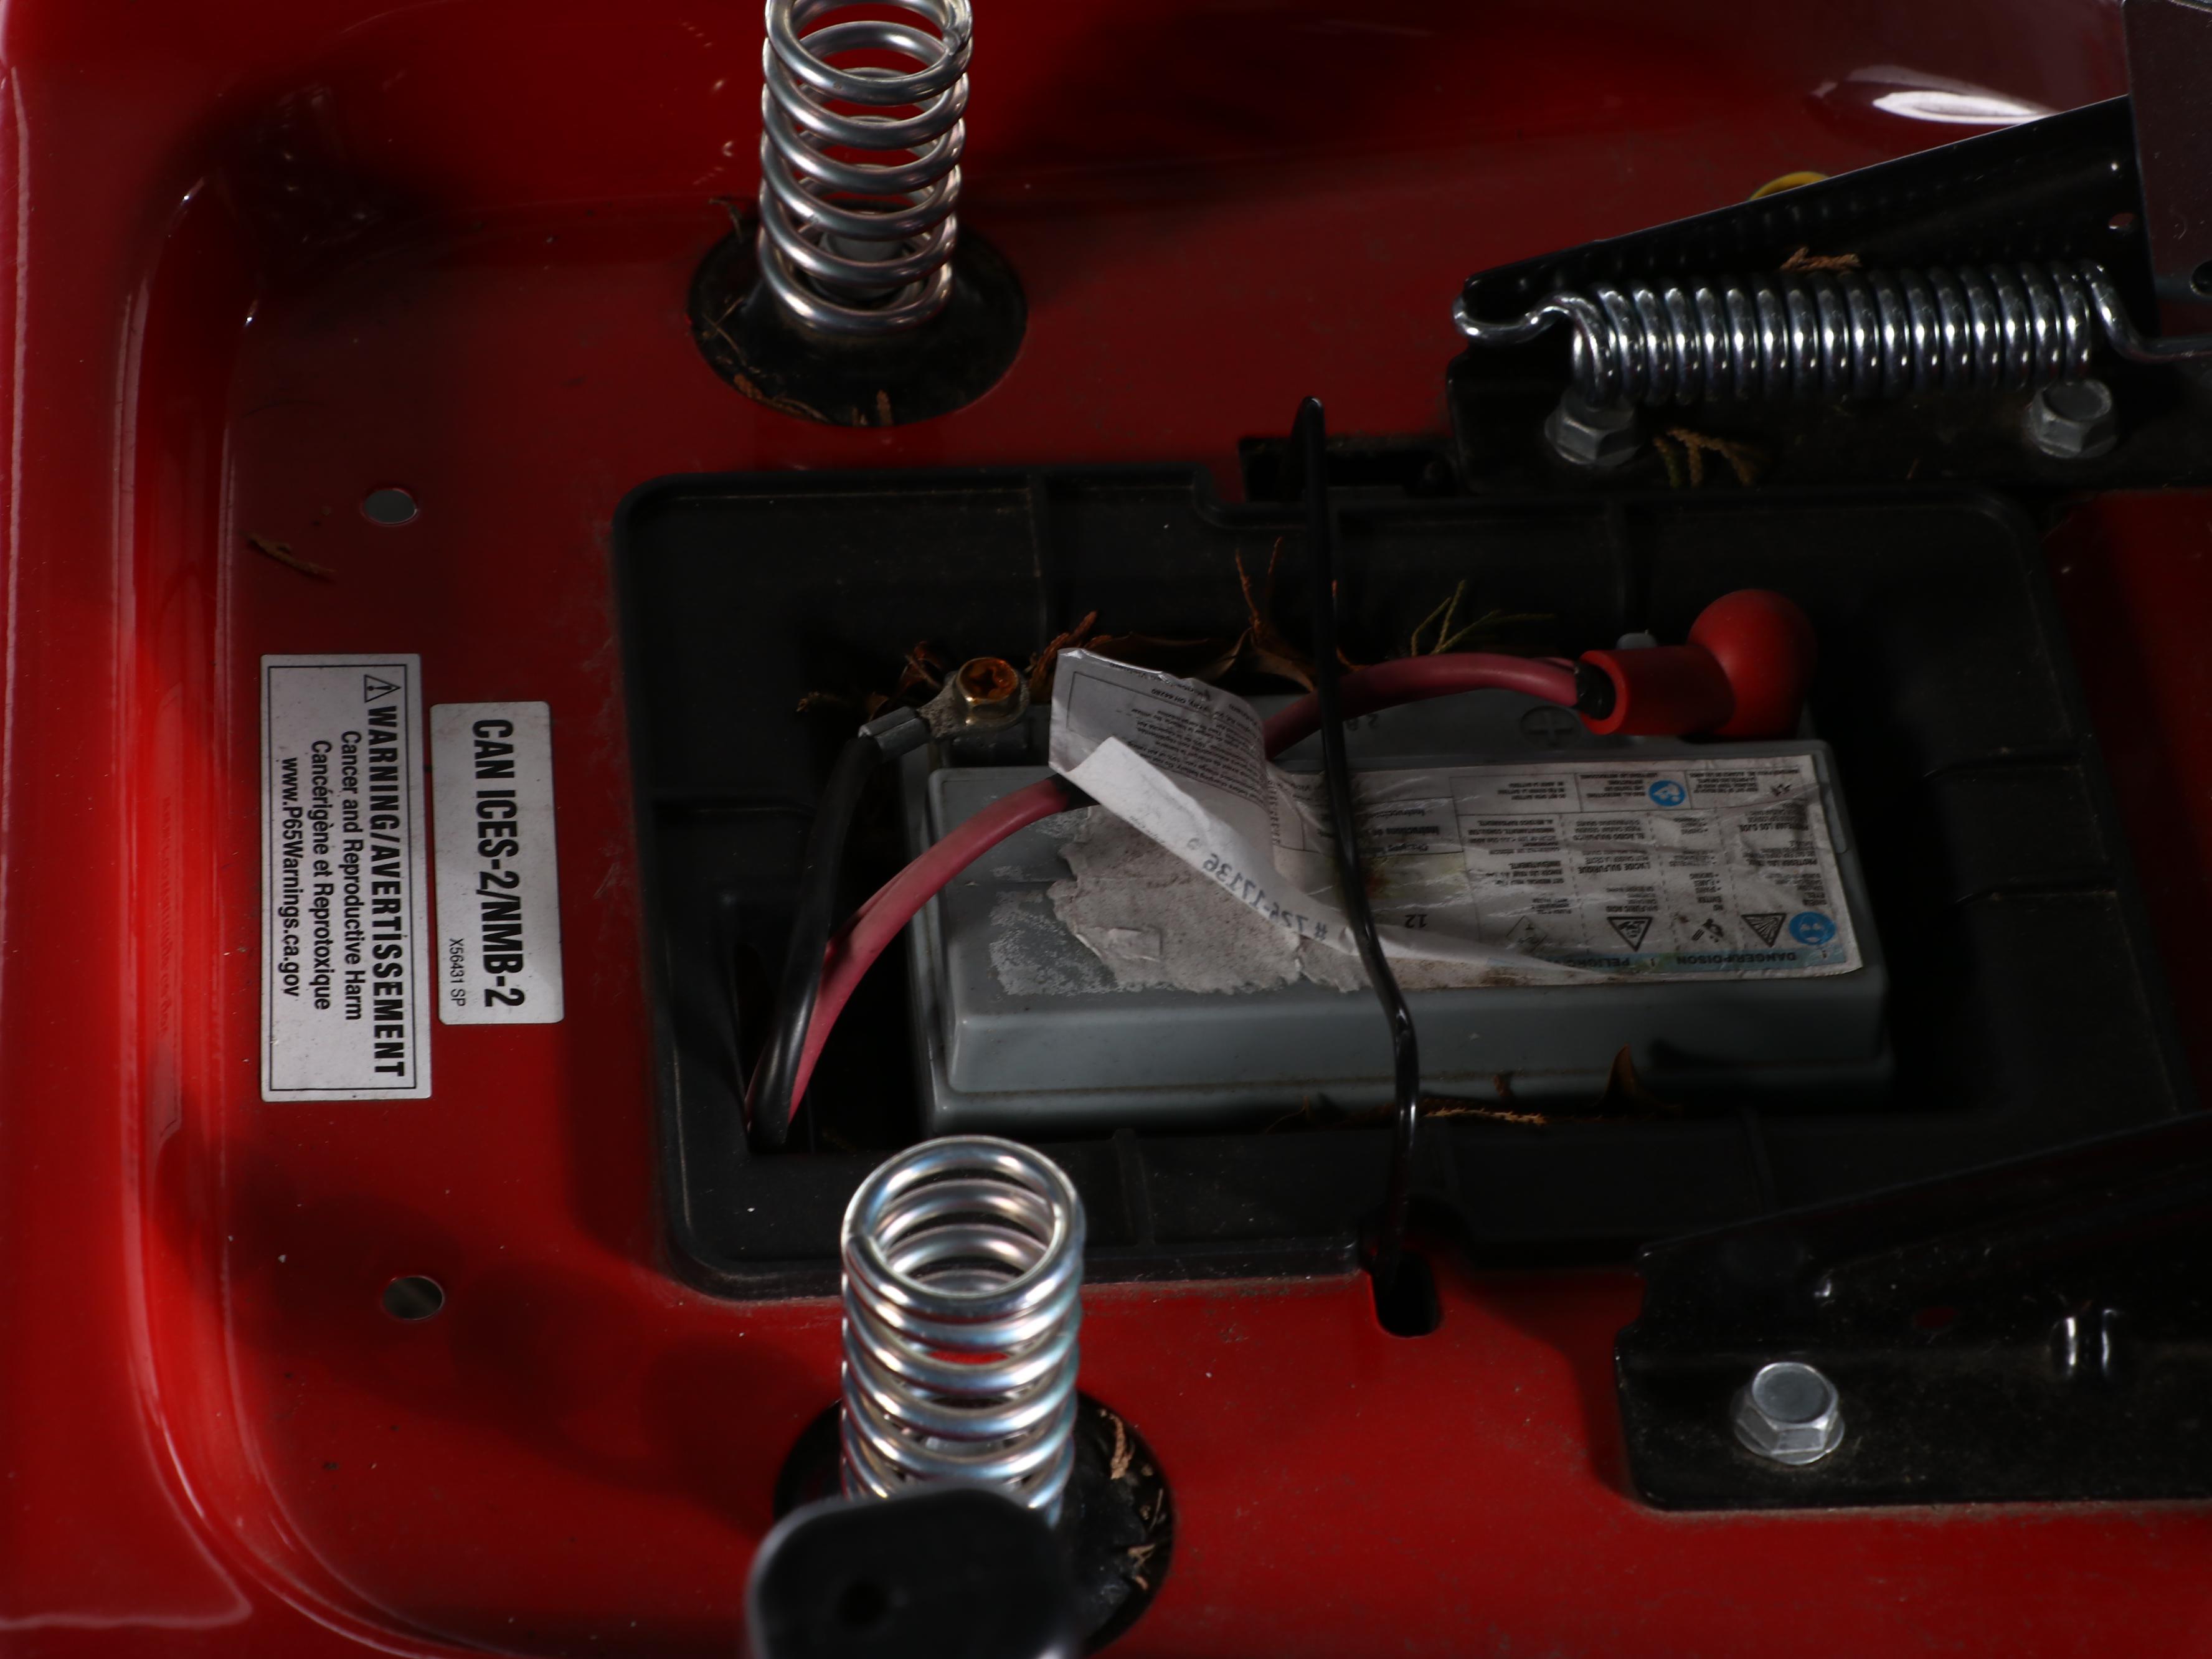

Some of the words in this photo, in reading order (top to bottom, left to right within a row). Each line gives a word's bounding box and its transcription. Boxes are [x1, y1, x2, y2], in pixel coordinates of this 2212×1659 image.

[342, 731, 361, 794] Cancer
[473, 720, 514, 778] CAN
[308, 740, 334, 854] Cancérigène
[343, 800, 363, 833] and
[278, 758, 304, 996] www.P65Warnings.ca.gov
[313, 860, 333, 877] et
[369, 706, 404, 1076] WARNING/AVERTISSEMENT
[476, 790, 524, 1007] ICES-2/NMB-2
[338, 839, 365, 964] Reproductive
[1404, 914, 1427, 929] 12
[308, 884, 335, 1009] Reprotoxique
[450, 938, 465, 983] X56431
[345, 971, 366, 1020] Harm
[451, 989, 466, 1006] SP
